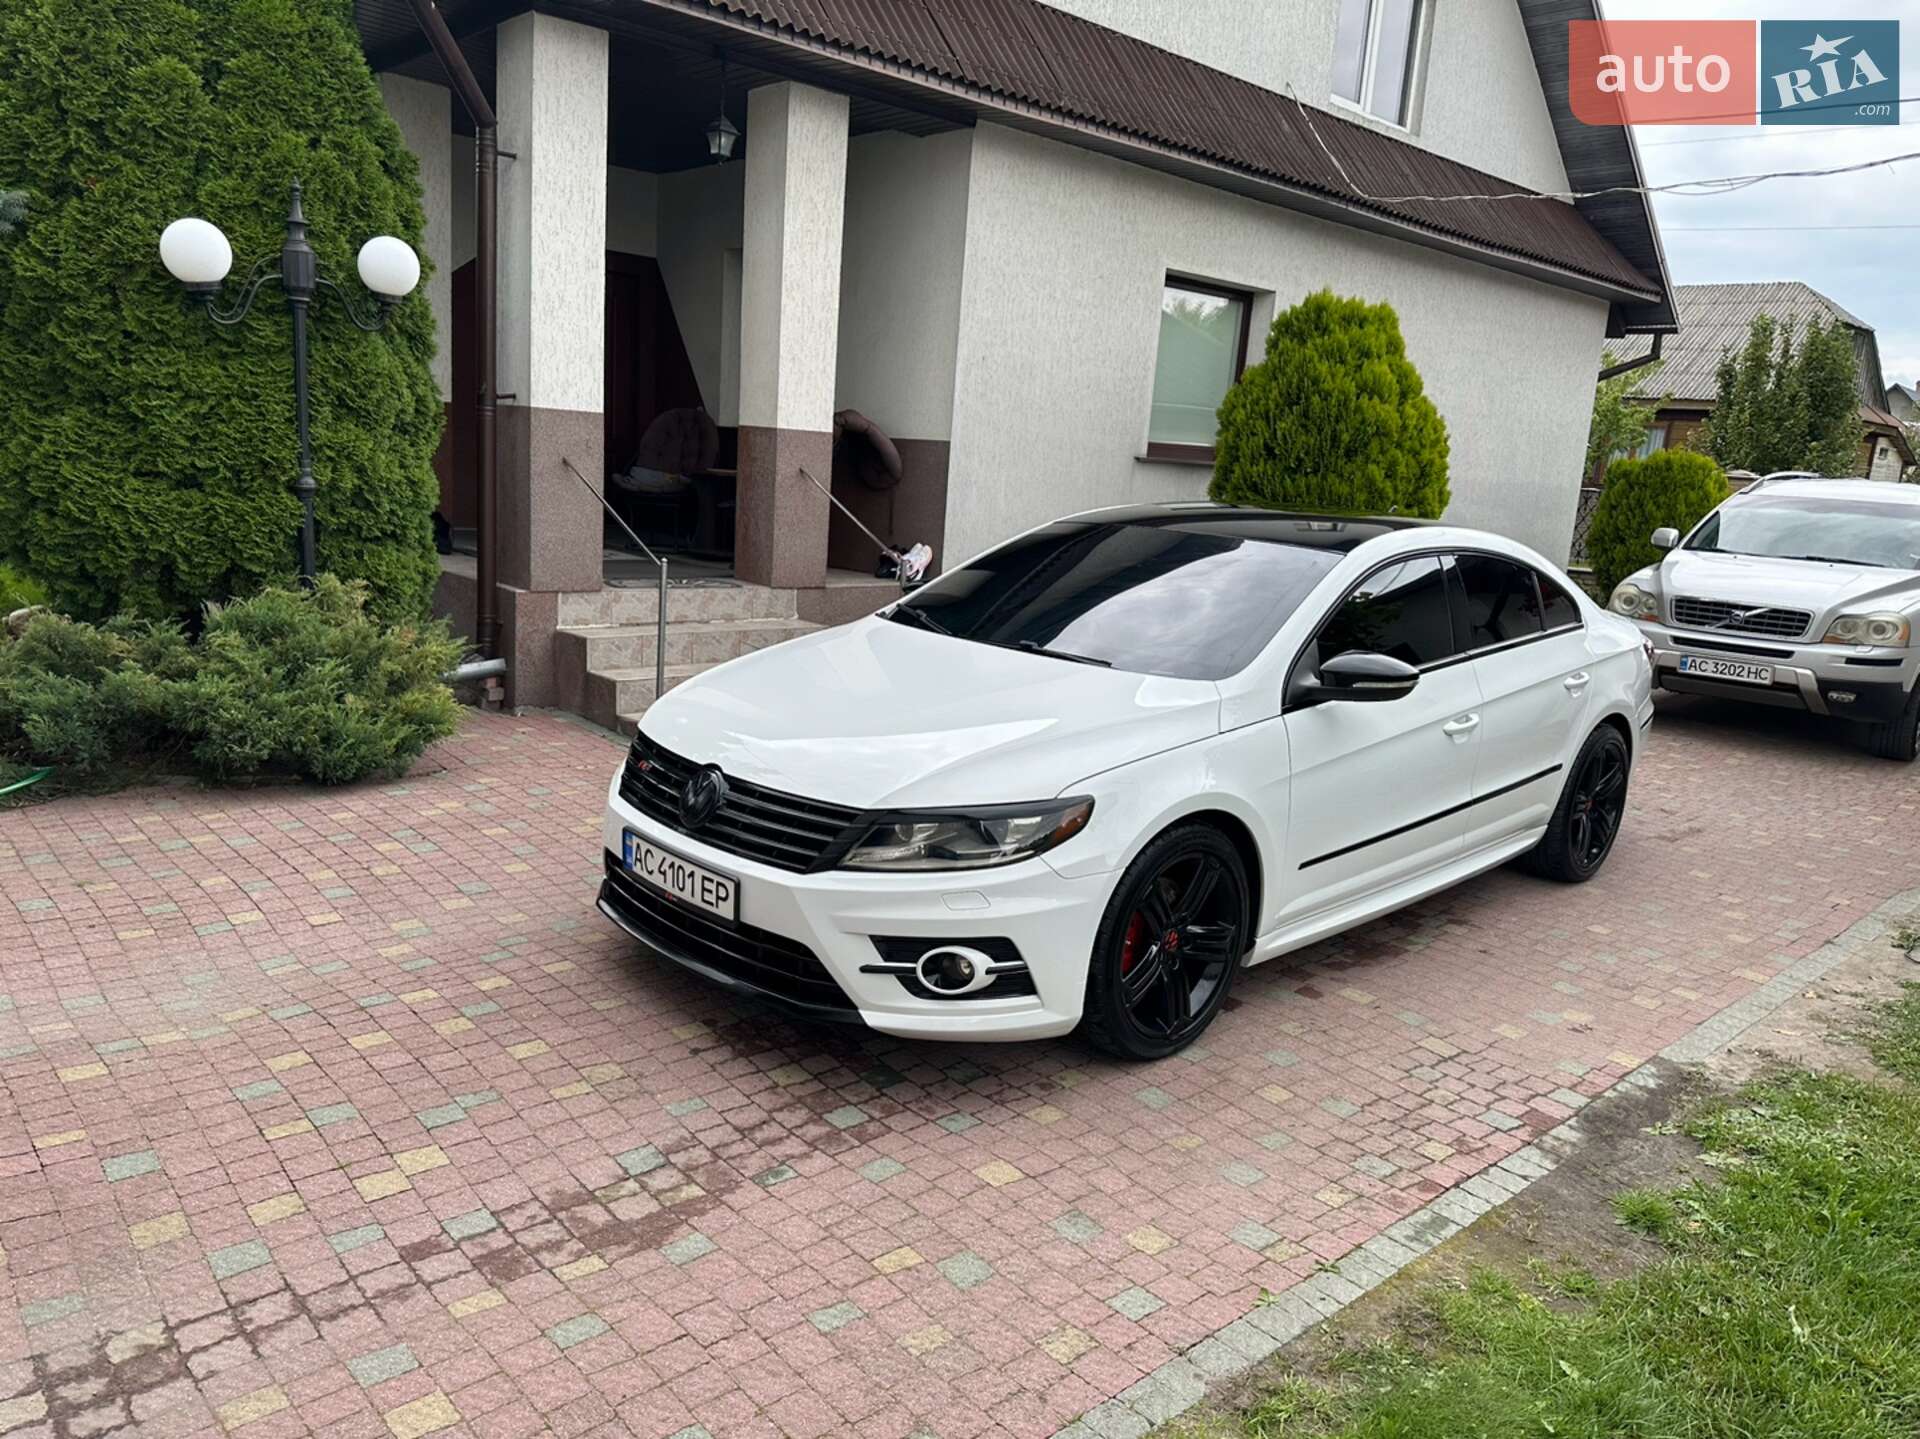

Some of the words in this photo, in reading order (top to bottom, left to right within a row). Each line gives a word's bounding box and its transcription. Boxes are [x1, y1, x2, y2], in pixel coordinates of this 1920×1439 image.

[1687, 658, 1709, 673] AC
[1711, 660, 1745, 678] 3202
[1746, 666, 1769, 681] HC
[634, 841, 655, 876] AC
[657, 856, 696, 899] 4101
[701, 874, 730, 910] EP
